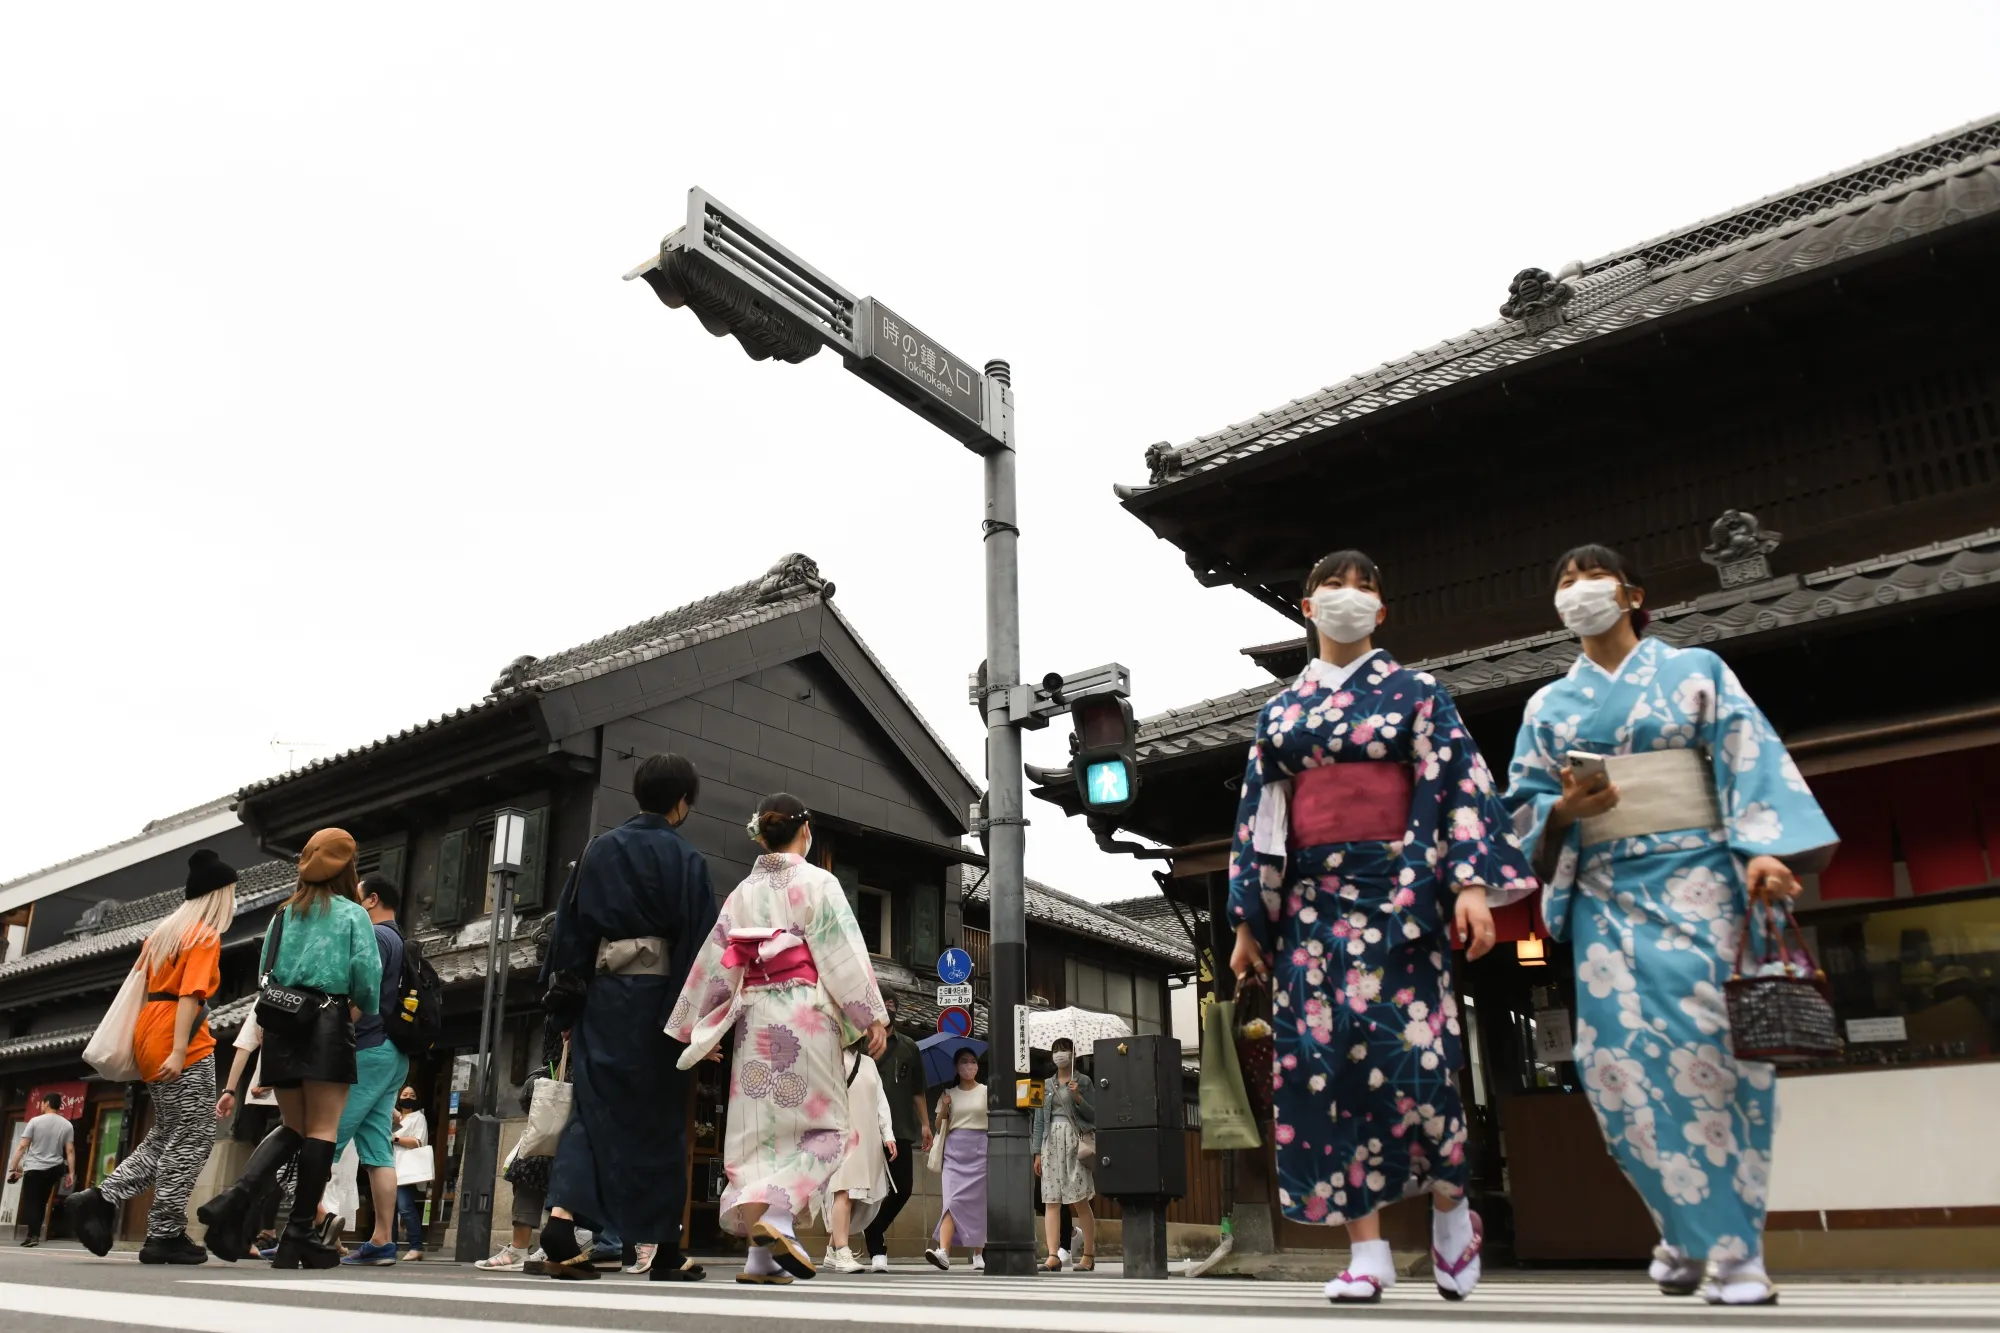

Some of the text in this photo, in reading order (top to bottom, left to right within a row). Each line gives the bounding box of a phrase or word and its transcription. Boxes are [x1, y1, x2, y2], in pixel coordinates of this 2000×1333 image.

[883, 316, 970, 395] 時の鐘入口
[902, 354, 953, 397] Tokinokane
[267, 988, 303, 1005] KENZO
[268, 996, 291, 1007] PARIS
